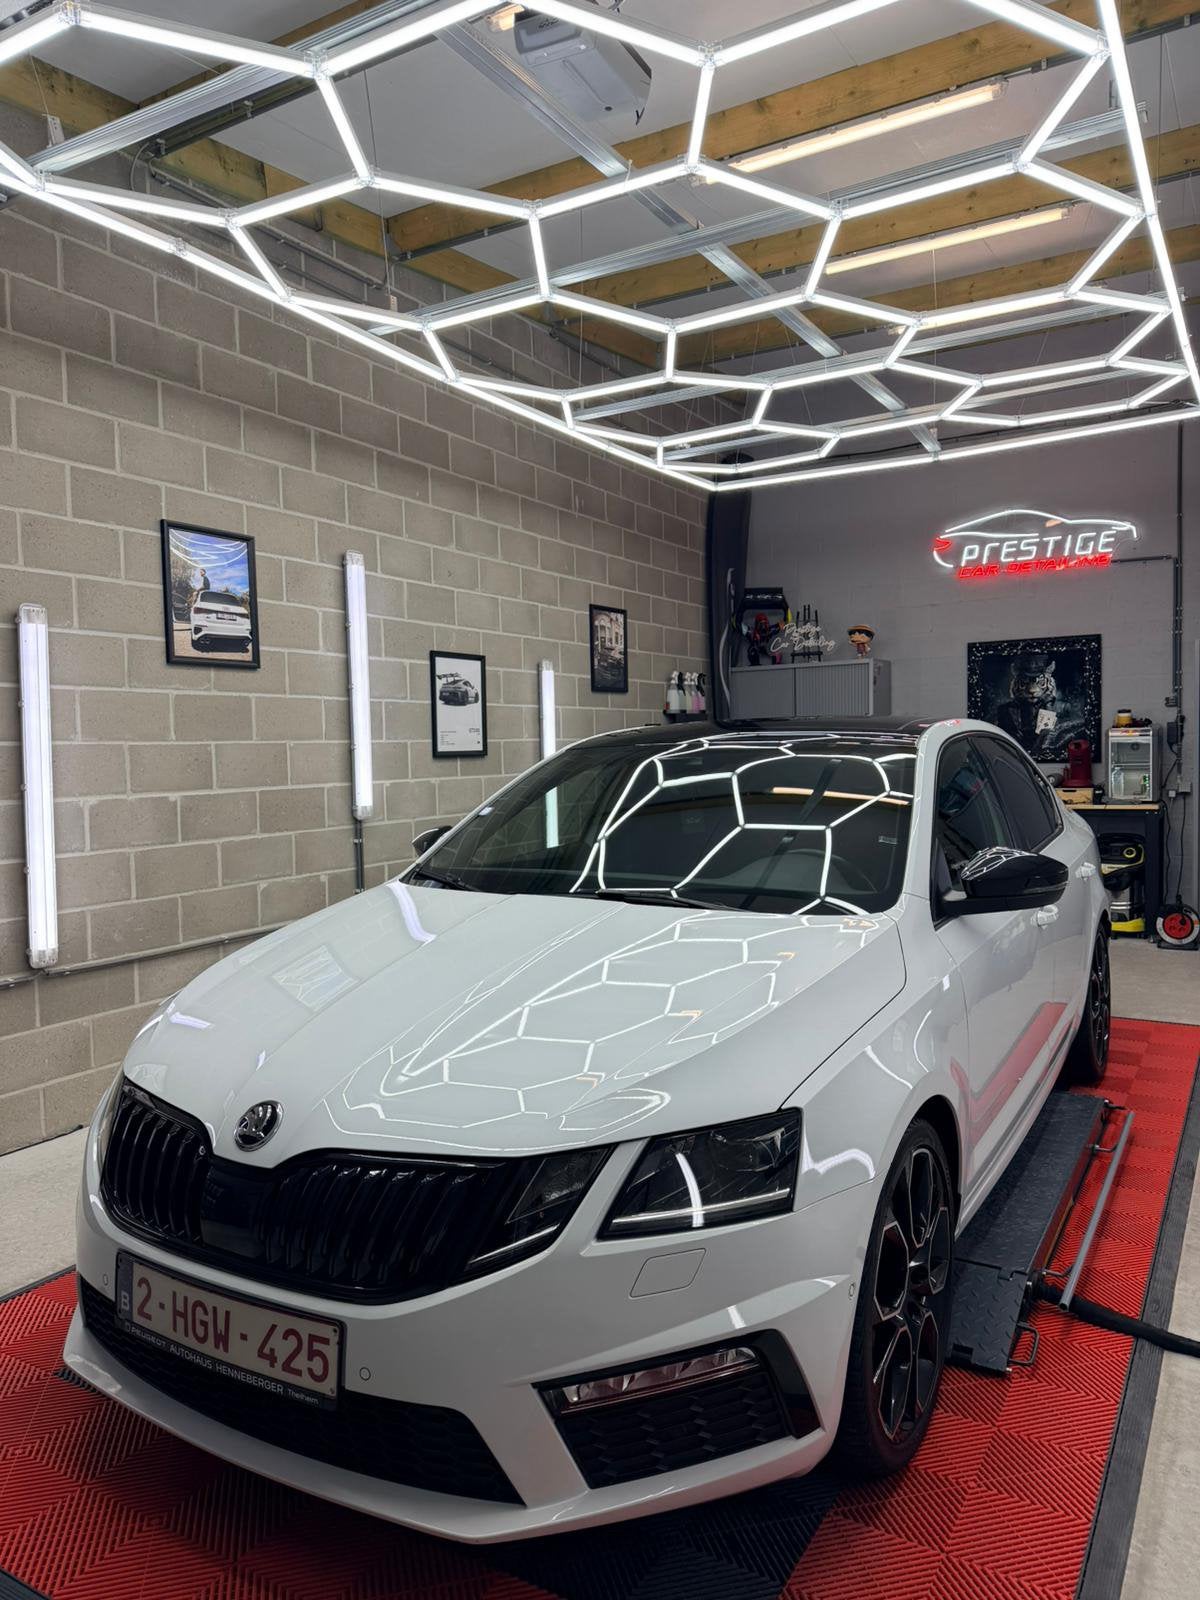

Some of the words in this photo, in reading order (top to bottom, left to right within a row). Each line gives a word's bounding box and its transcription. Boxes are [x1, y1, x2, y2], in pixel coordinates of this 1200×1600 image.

[958, 564, 1000, 579] CAR
[1006, 553, 1113, 574] DETAILING
[121, 1291, 129, 1311] B
[169, 1344, 213, 1369] AUTOHAUS
[216, 1362, 284, 1394] HENNEBERGER
